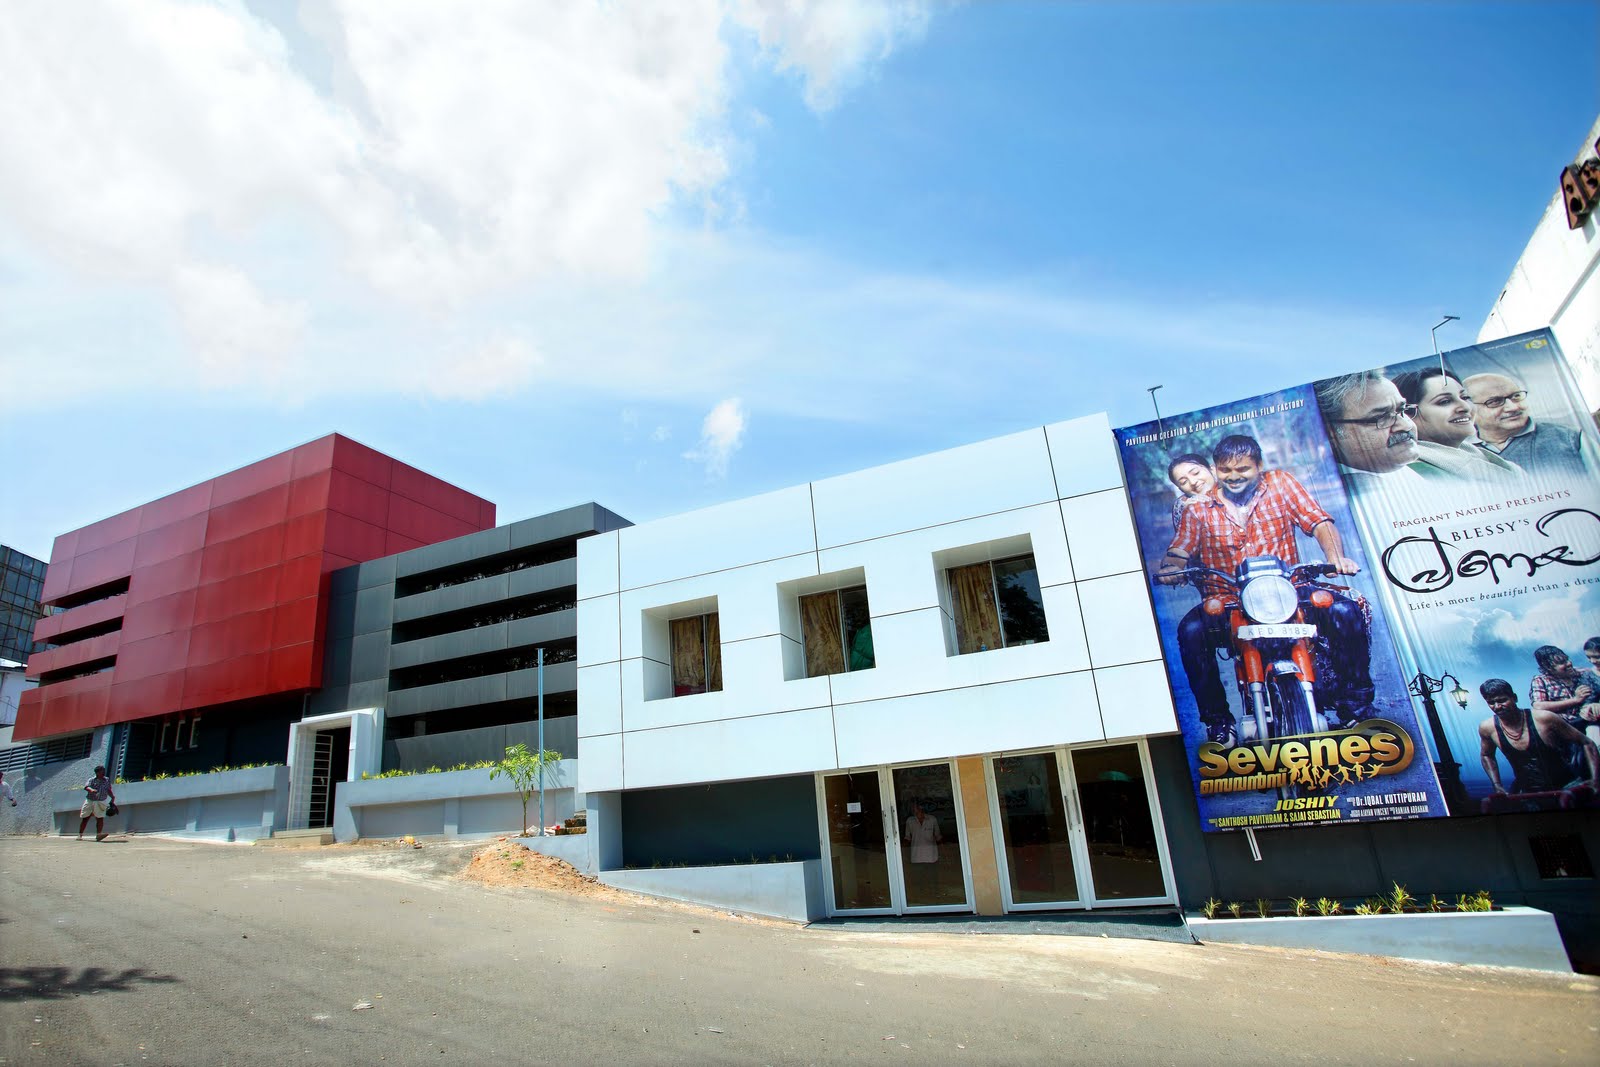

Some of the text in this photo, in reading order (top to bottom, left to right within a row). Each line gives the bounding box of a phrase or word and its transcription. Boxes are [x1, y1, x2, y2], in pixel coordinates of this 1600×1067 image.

[1126, 433, 1158, 446] PAVITHRAM
[1159, 427, 1187, 440] CREATION
[1195, 421, 1209, 431] ZION
[1211, 410, 1258, 428] INTERNATIONAL
[1260, 405, 1275, 416] FILM
[1277, 399, 1304, 412] FACTORY
[1393, 489, 1571, 529] FRAGRANT NATURE PRESENTS
[1451, 518, 1530, 542] BLESSY'S
[1409, 601, 1431, 611] Life
[1435, 599, 1444, 607] is
[1448, 596, 1475, 605] more
[1479, 586, 1528, 601] beautiful
[1532, 582, 1560, 593] than
[1574, 576, 1600, 586] drea
[1198, 733, 1401, 777] Sevenes
[1218, 815, 1248, 827] SANTHOSH
[1249, 813, 1282, 825] PAVITHRAM
[1307, 809, 1341, 820] SEBASTIAN
[1273, 795, 1339, 812] JOSHIY
